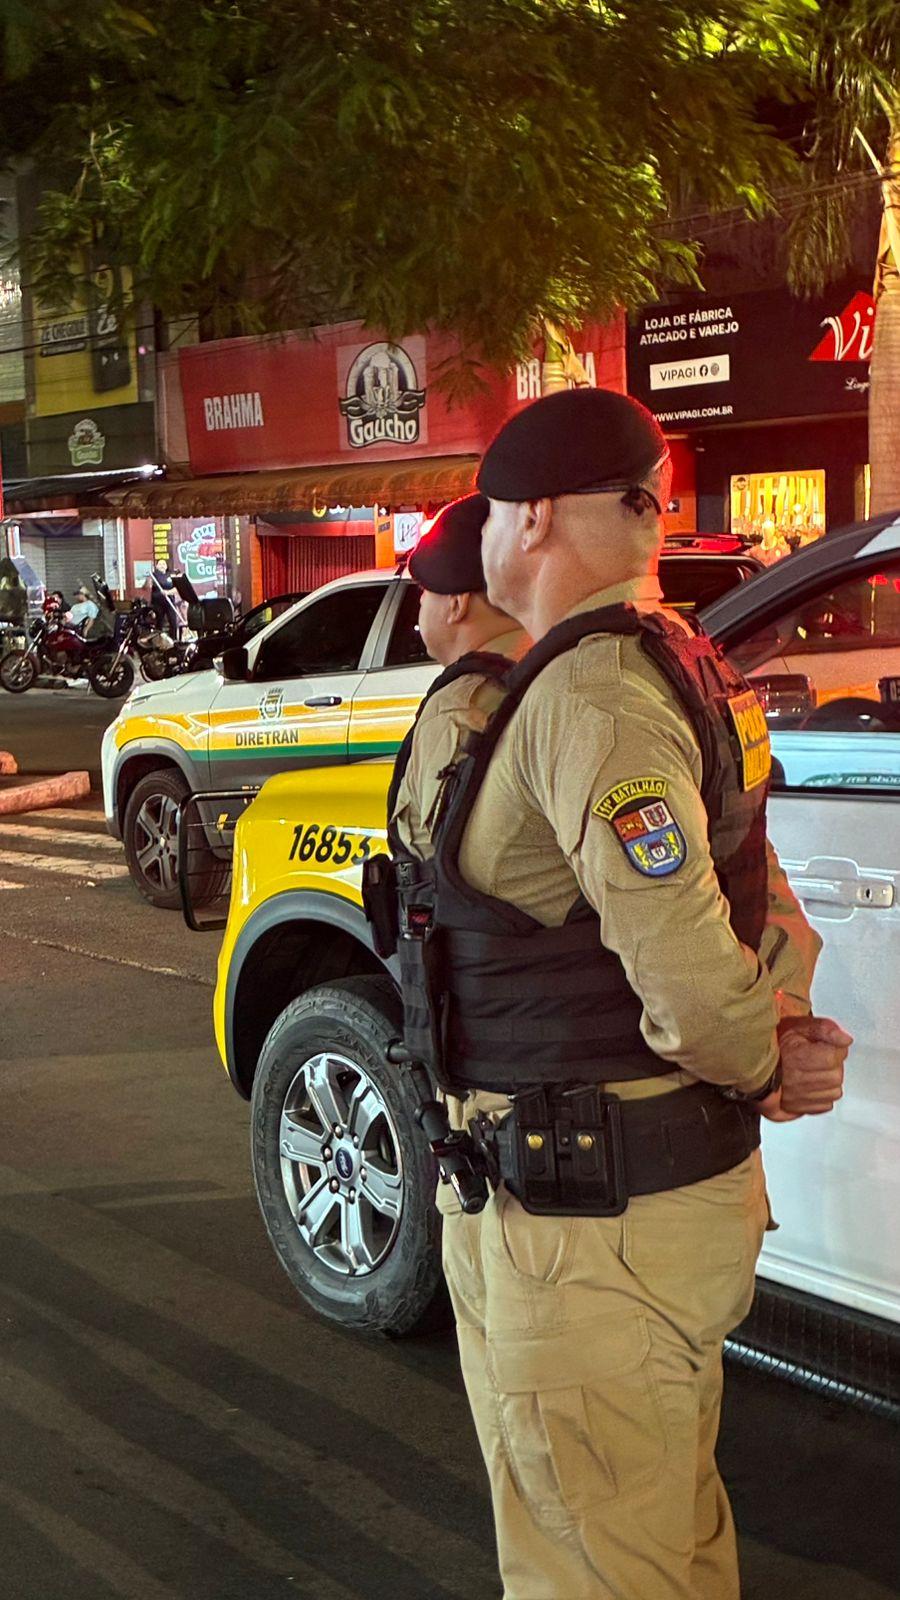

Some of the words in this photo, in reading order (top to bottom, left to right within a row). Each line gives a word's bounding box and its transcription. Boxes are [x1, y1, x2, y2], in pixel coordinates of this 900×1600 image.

[640, 329, 688, 345] ATACADO
[689, 328, 697, 339] E
[698, 321, 739, 337] VAREJO
[645, 317, 672, 330] LOJA
[673, 314, 687, 326] DE
[689, 307, 733, 323] FÁBRICA
[820, 307, 874, 361] Vi
[516, 352, 597, 400] BRA
[660, 367, 696, 381] VIPAGI
[203, 392, 264, 431] BRAHMA
[350, 413, 417, 444] Gaucho
[235, 729, 299, 746] DIRETRAN
[289, 824, 371, 865] 16853
